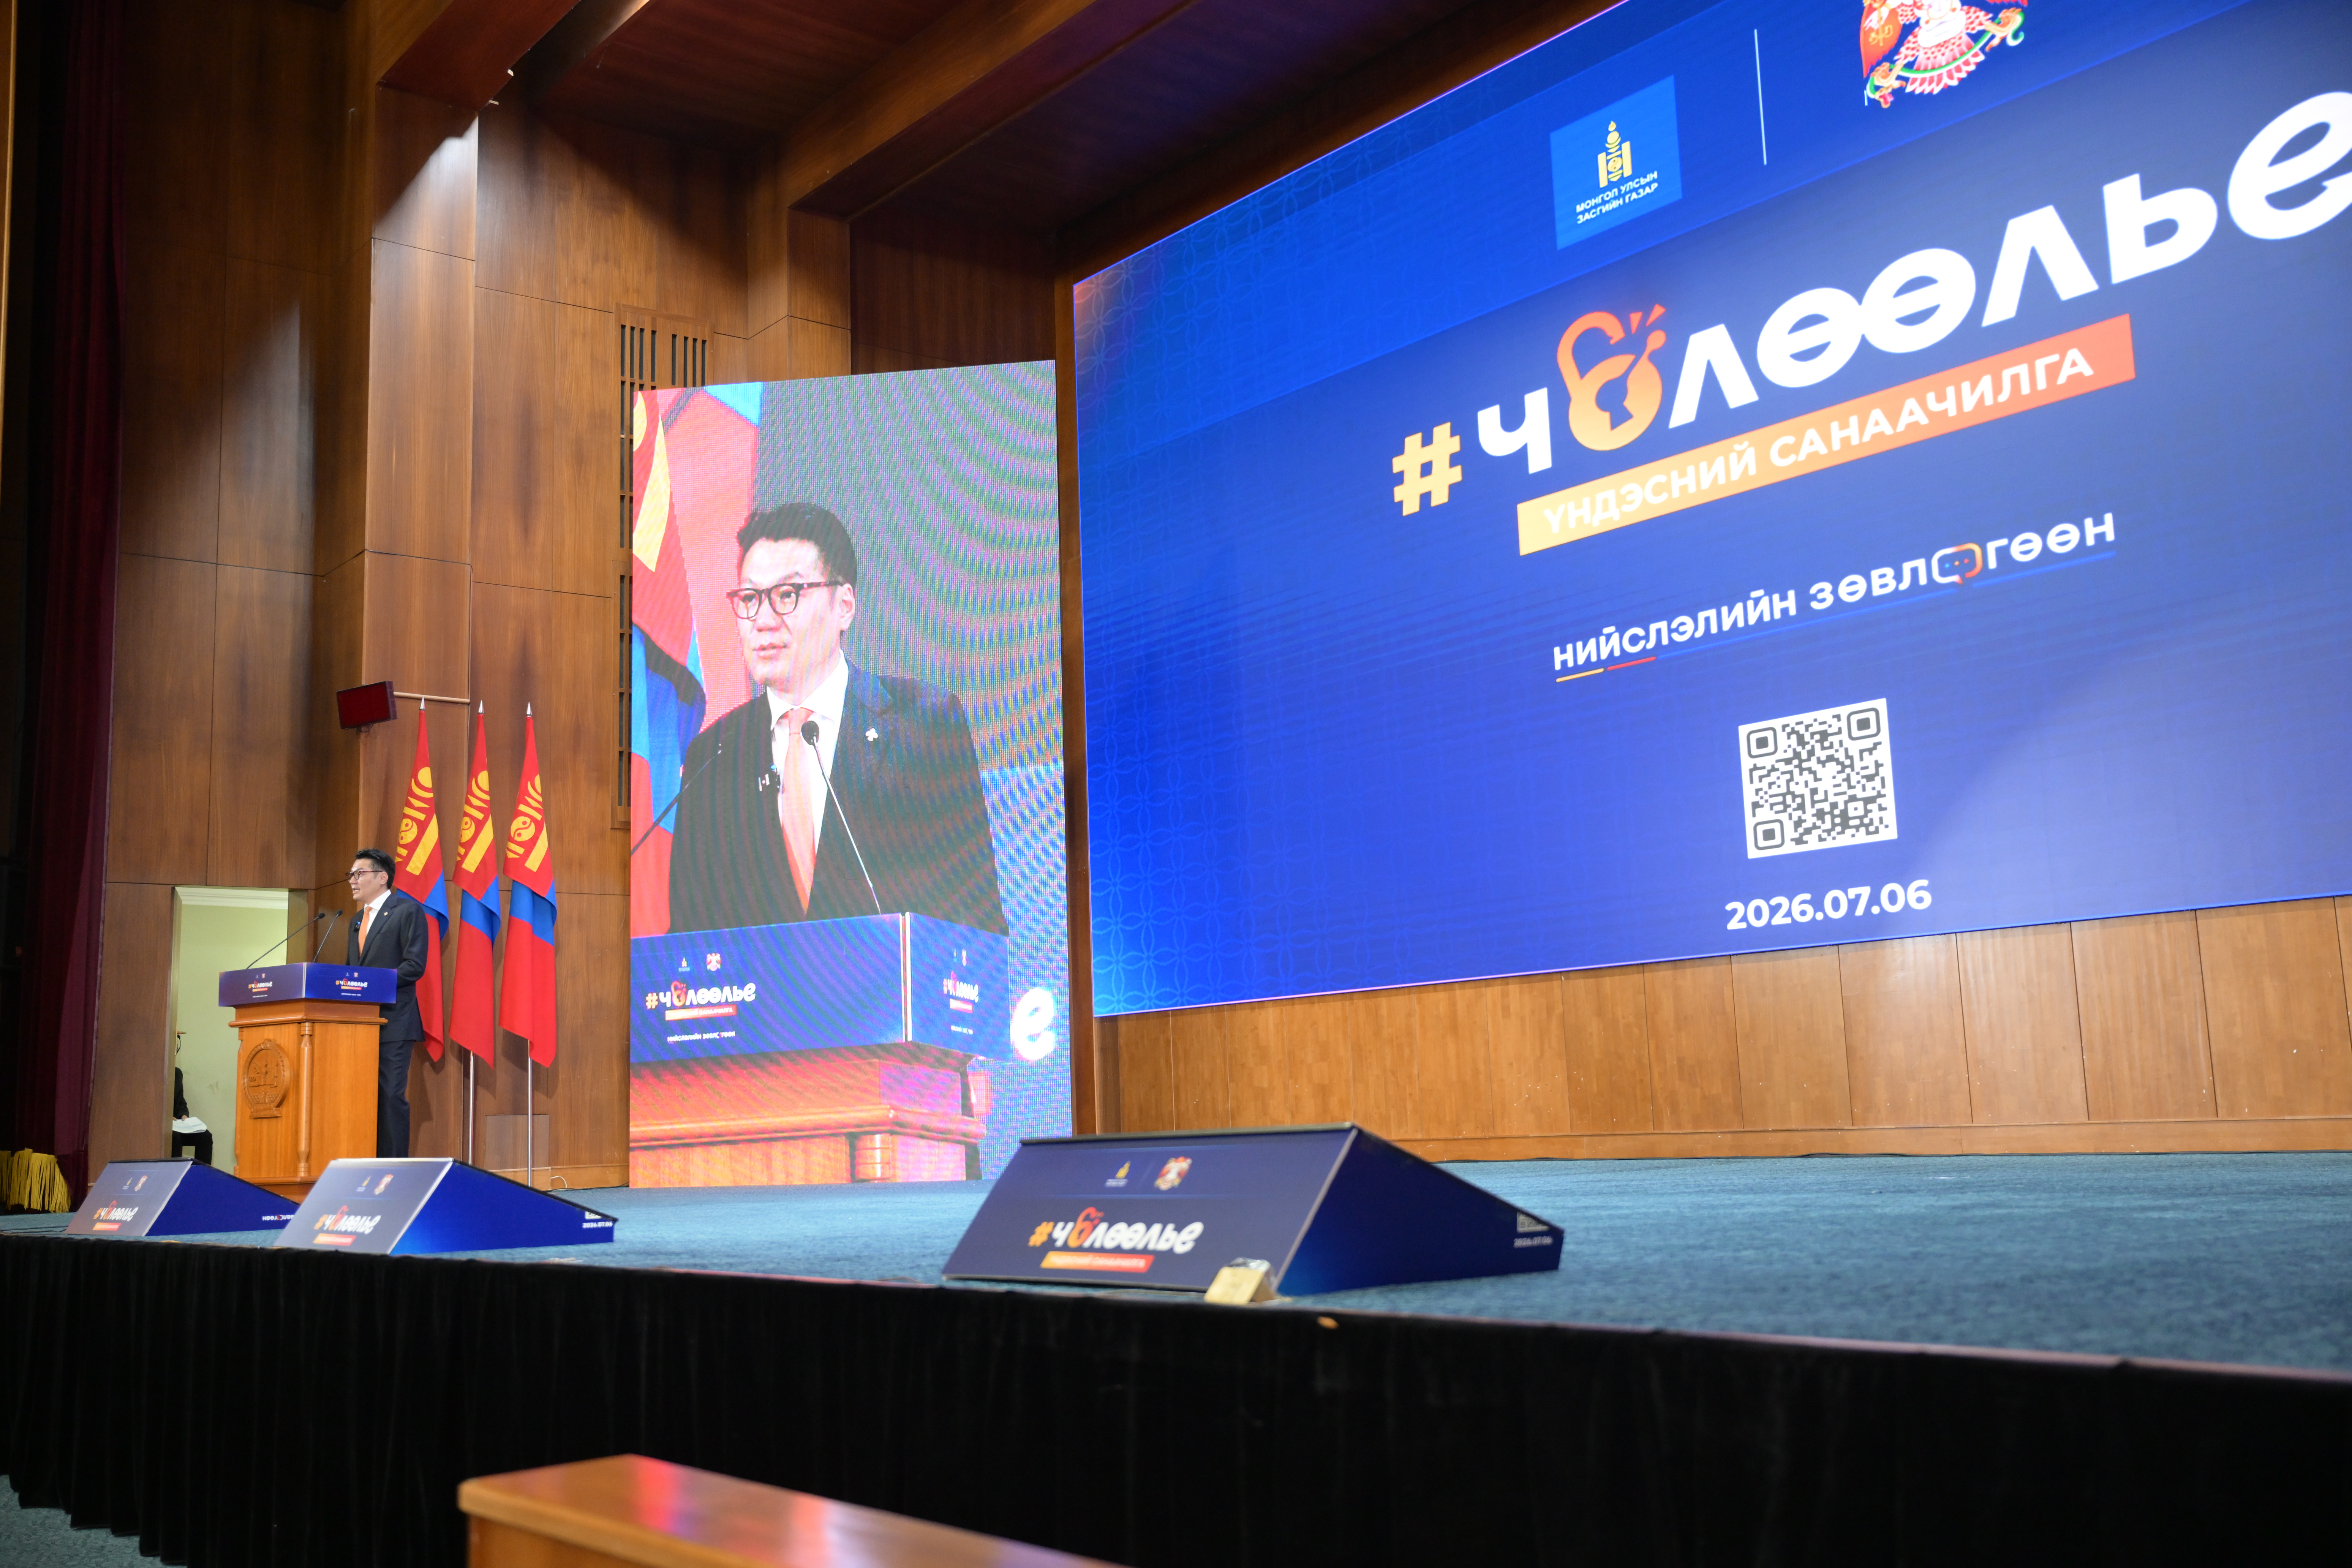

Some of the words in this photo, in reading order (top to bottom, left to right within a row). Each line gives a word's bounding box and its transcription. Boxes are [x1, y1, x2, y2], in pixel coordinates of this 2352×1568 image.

[1576, 188, 1618, 213] МОНГОЛ
[1620, 170, 1658, 194] УЛСЫН
[1577, 197, 1623, 224] ЗАСГИЙН
[1625, 182, 1658, 203] ГАЗАР
[1543, 441, 1757, 534] ҮНДЭСНИЙ
[1769, 347, 2094, 469] САНААЧИЛГА
[1553, 588, 1797, 671] НИЙСЛЭЛИЙН
[1724, 879, 1932, 930] 2026.07.06
